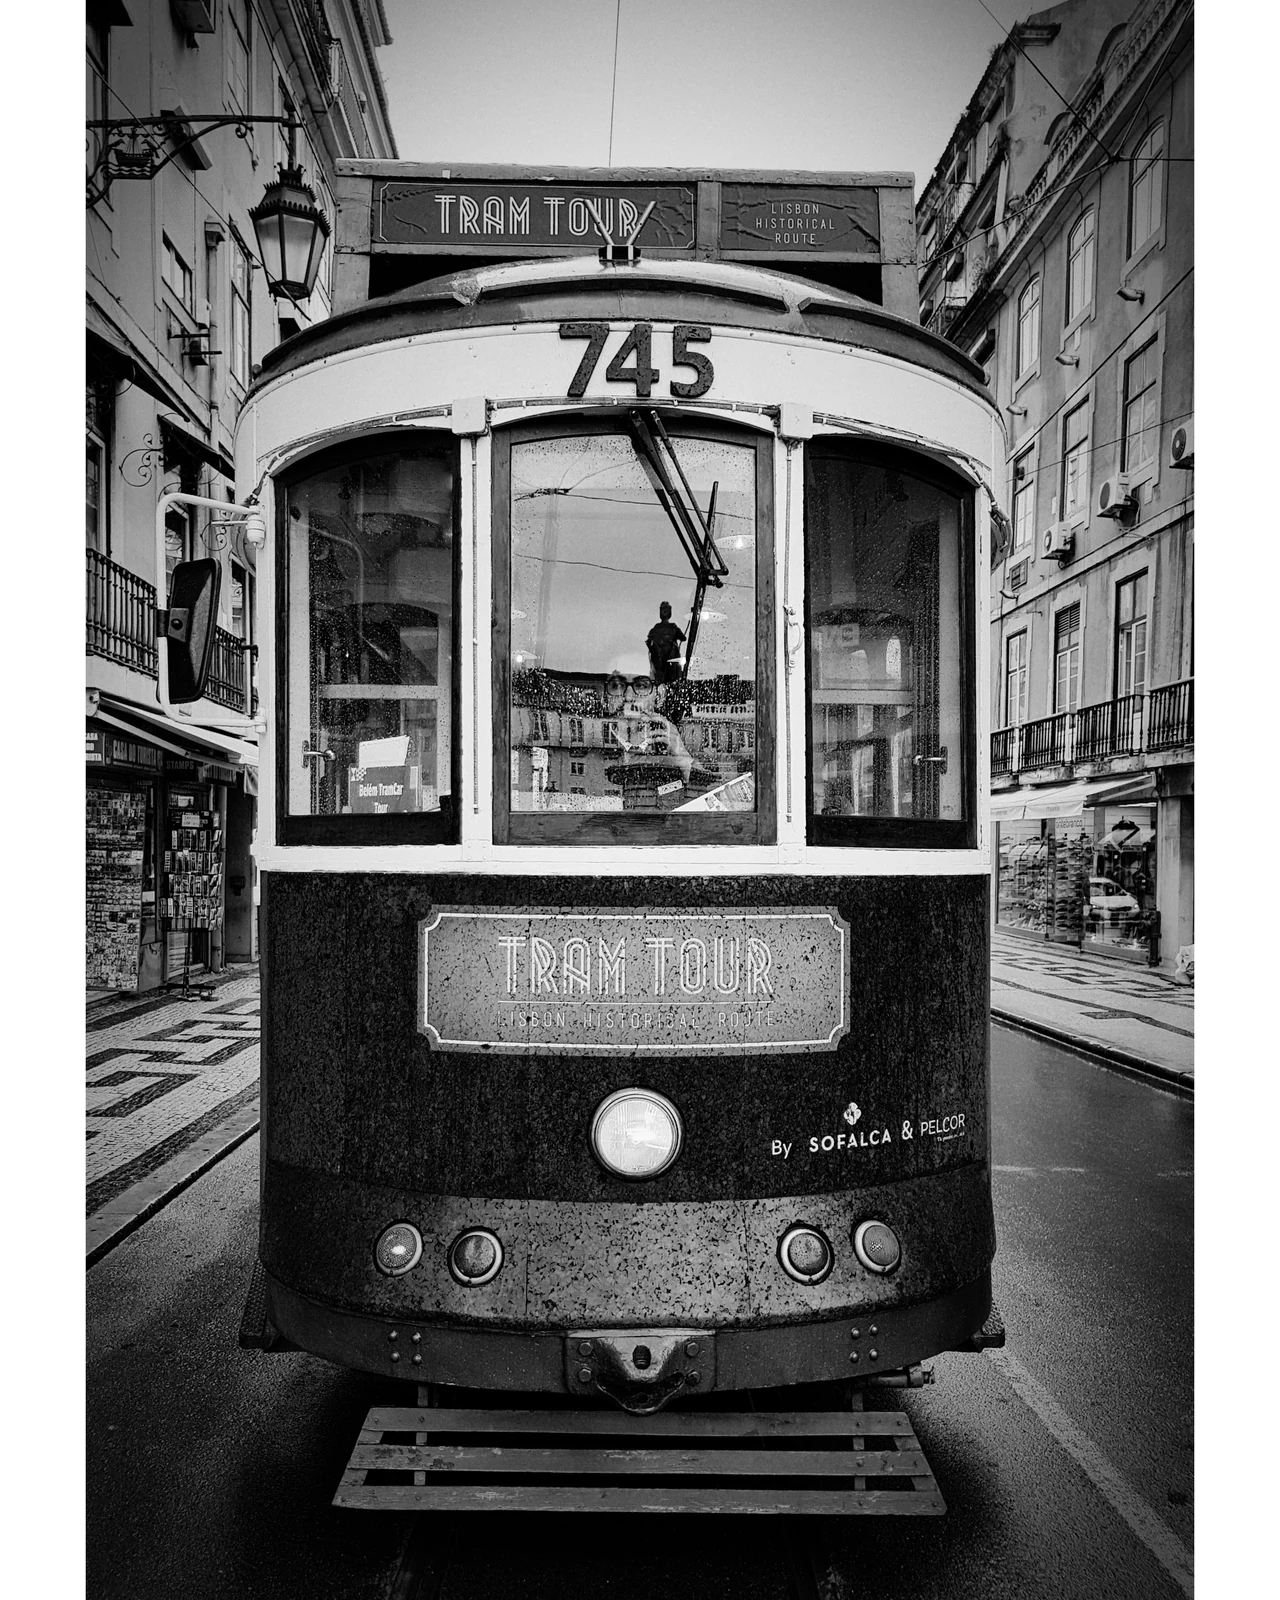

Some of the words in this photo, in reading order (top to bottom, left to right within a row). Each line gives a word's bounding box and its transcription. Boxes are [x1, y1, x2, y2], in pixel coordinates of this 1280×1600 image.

[434, 195, 530, 235] TRAM
[543, 197, 640, 237] TOUR
[771, 203, 819, 214] LISBON
[755, 218, 835, 230] HISTORICAL
[775, 233, 816, 244] ROUTE
[559, 323, 715, 398] 745
[166, 760, 194, 770] STAMPS
[498, 936, 627, 996] TRAM
[646, 937, 774, 996] TOUR
[497, 1010, 566, 1028] LISBON
[583, 1011, 699, 1029] HISTORICAL
[718, 1010, 775, 1027] ROUTE
[771, 1139, 793, 1159] By
[809, 1128, 892, 1153] SOFALCA
[901, 1119, 914, 1141] &
[920, 1113, 966, 1137] PELCOR
